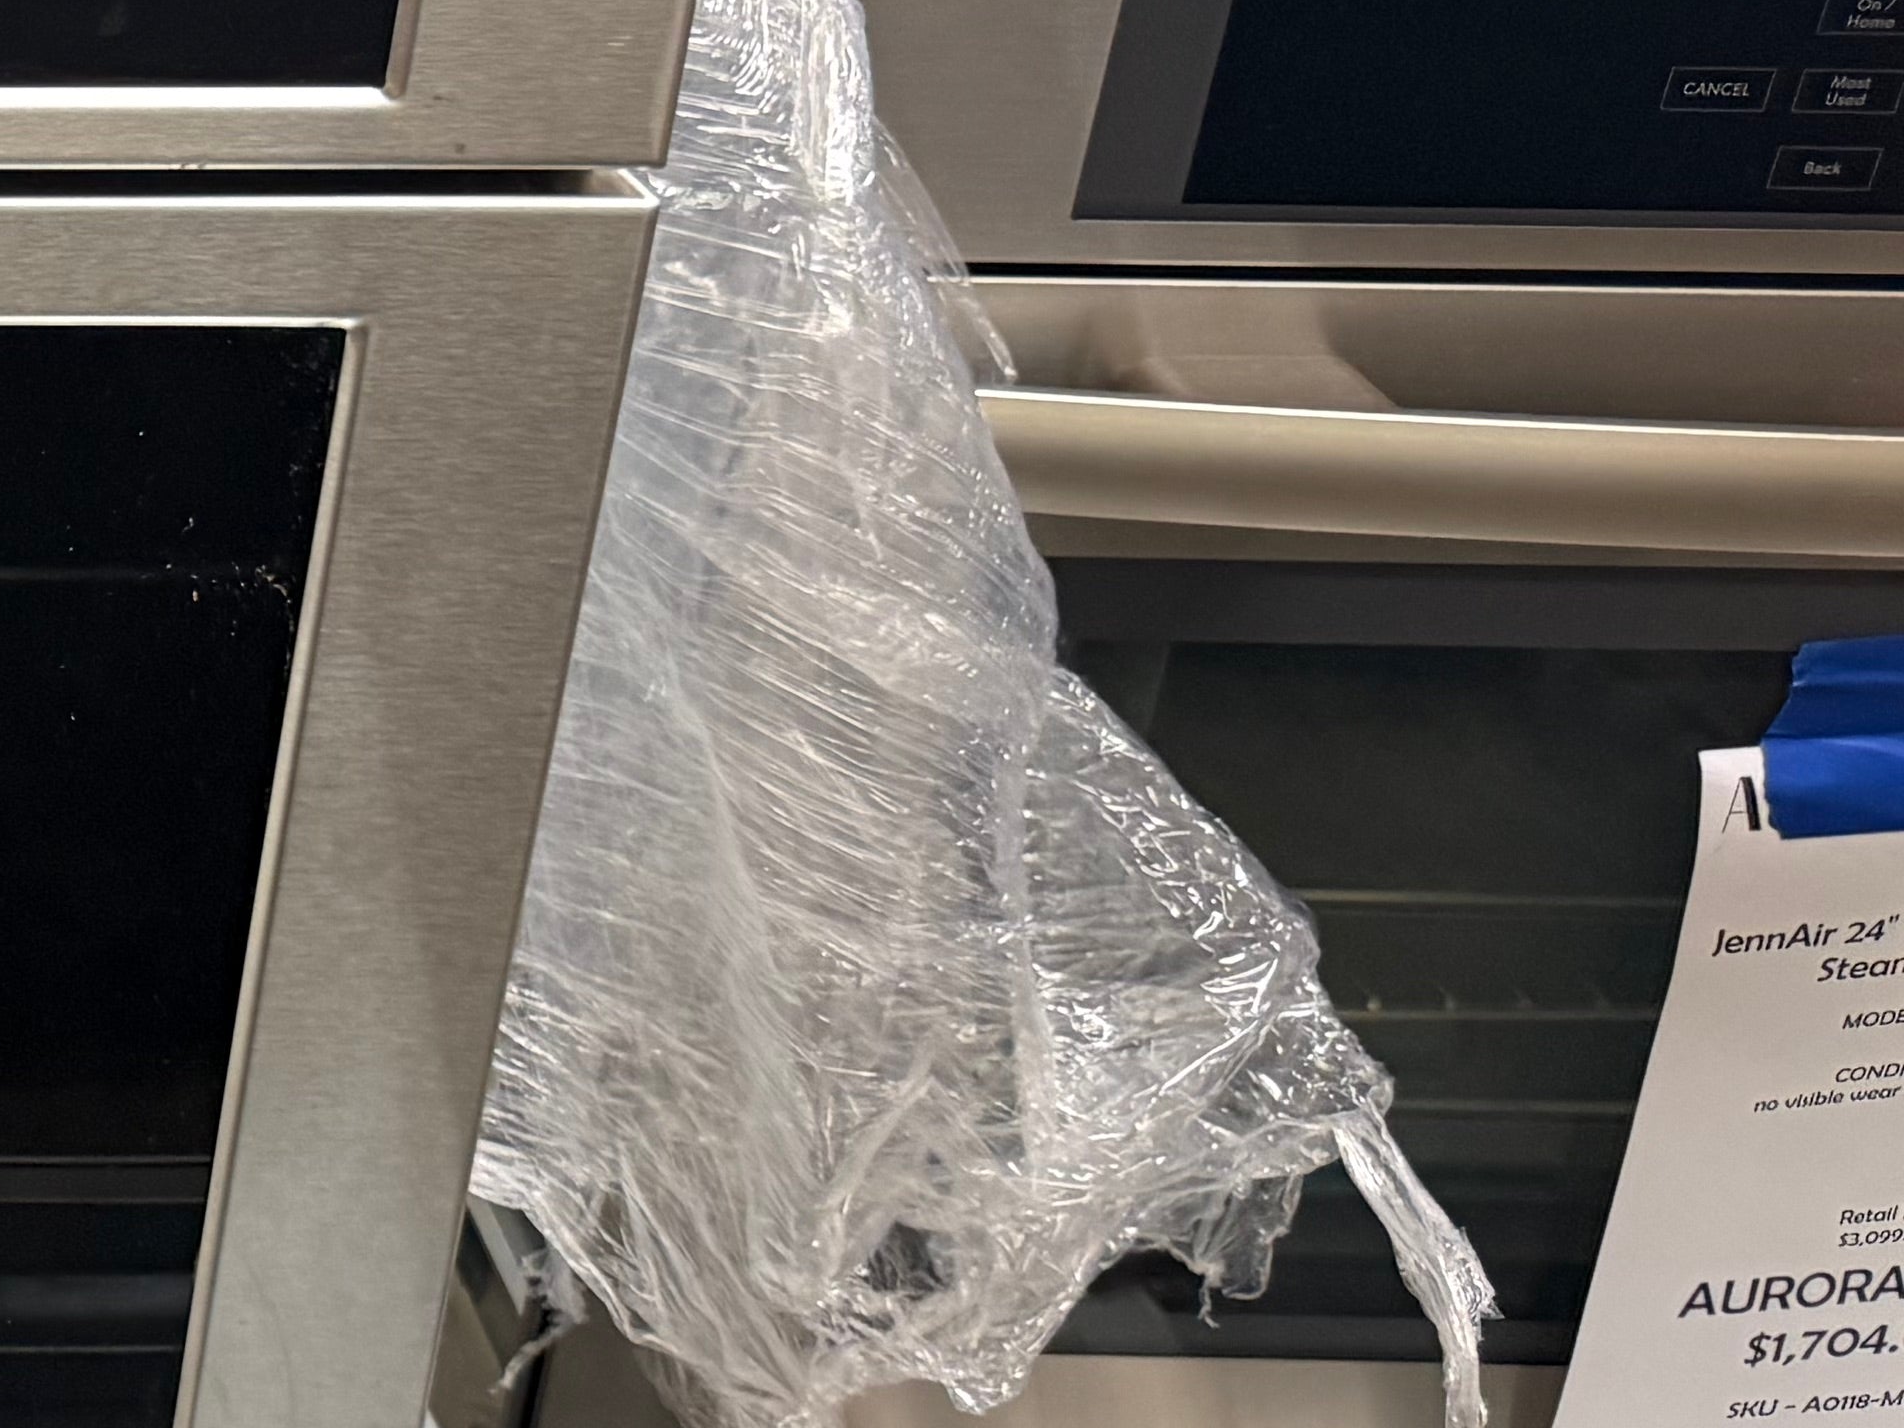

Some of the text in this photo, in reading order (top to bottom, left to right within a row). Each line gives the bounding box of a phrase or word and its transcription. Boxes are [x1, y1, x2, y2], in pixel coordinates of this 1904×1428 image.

[1846, 14, 1896, 29] Home
[1683, 82, 1750, 97] CANCEL
[1830, 76, 1873, 90] Most
[1825, 93, 1868, 106] Used
[1803, 161, 1842, 175] Back
[1722, 775, 1762, 833] A
[1711, 914, 1900, 958] JennAir 24"
[1754, 1085, 1900, 1113] no visible wear
[1840, 1205, 1898, 1225] Retail
[1677, 1265, 1904, 1318] AURORA
[1744, 1324, 1904, 1368] $1,704.
[1726, 1399, 1779, 1419] SKU
